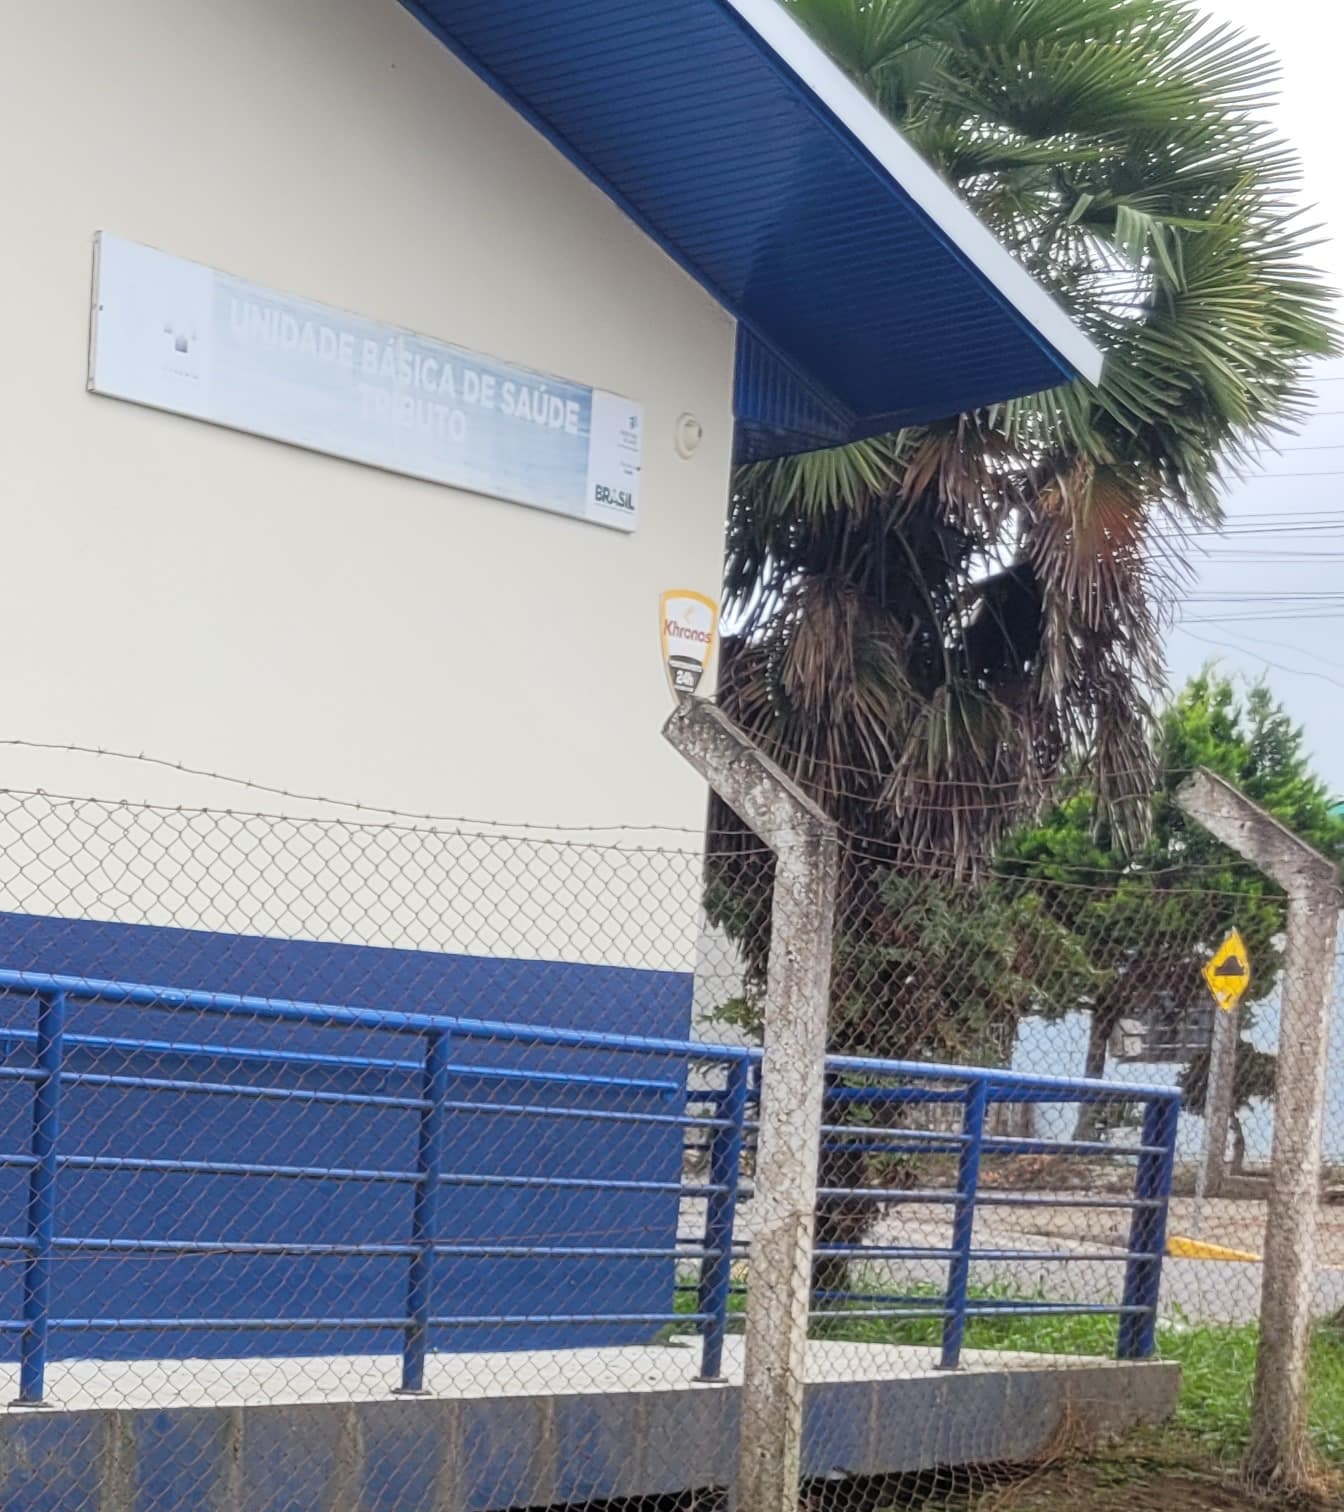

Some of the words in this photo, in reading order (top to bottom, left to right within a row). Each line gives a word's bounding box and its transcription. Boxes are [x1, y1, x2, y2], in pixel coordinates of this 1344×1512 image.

[230, 297, 355, 369] UNIDADE
[361, 337, 456, 399] BÁSICA
[463, 368, 496, 409] DE
[502, 382, 579, 434] SAÚDE
[595, 484, 635, 511] BRASIL
